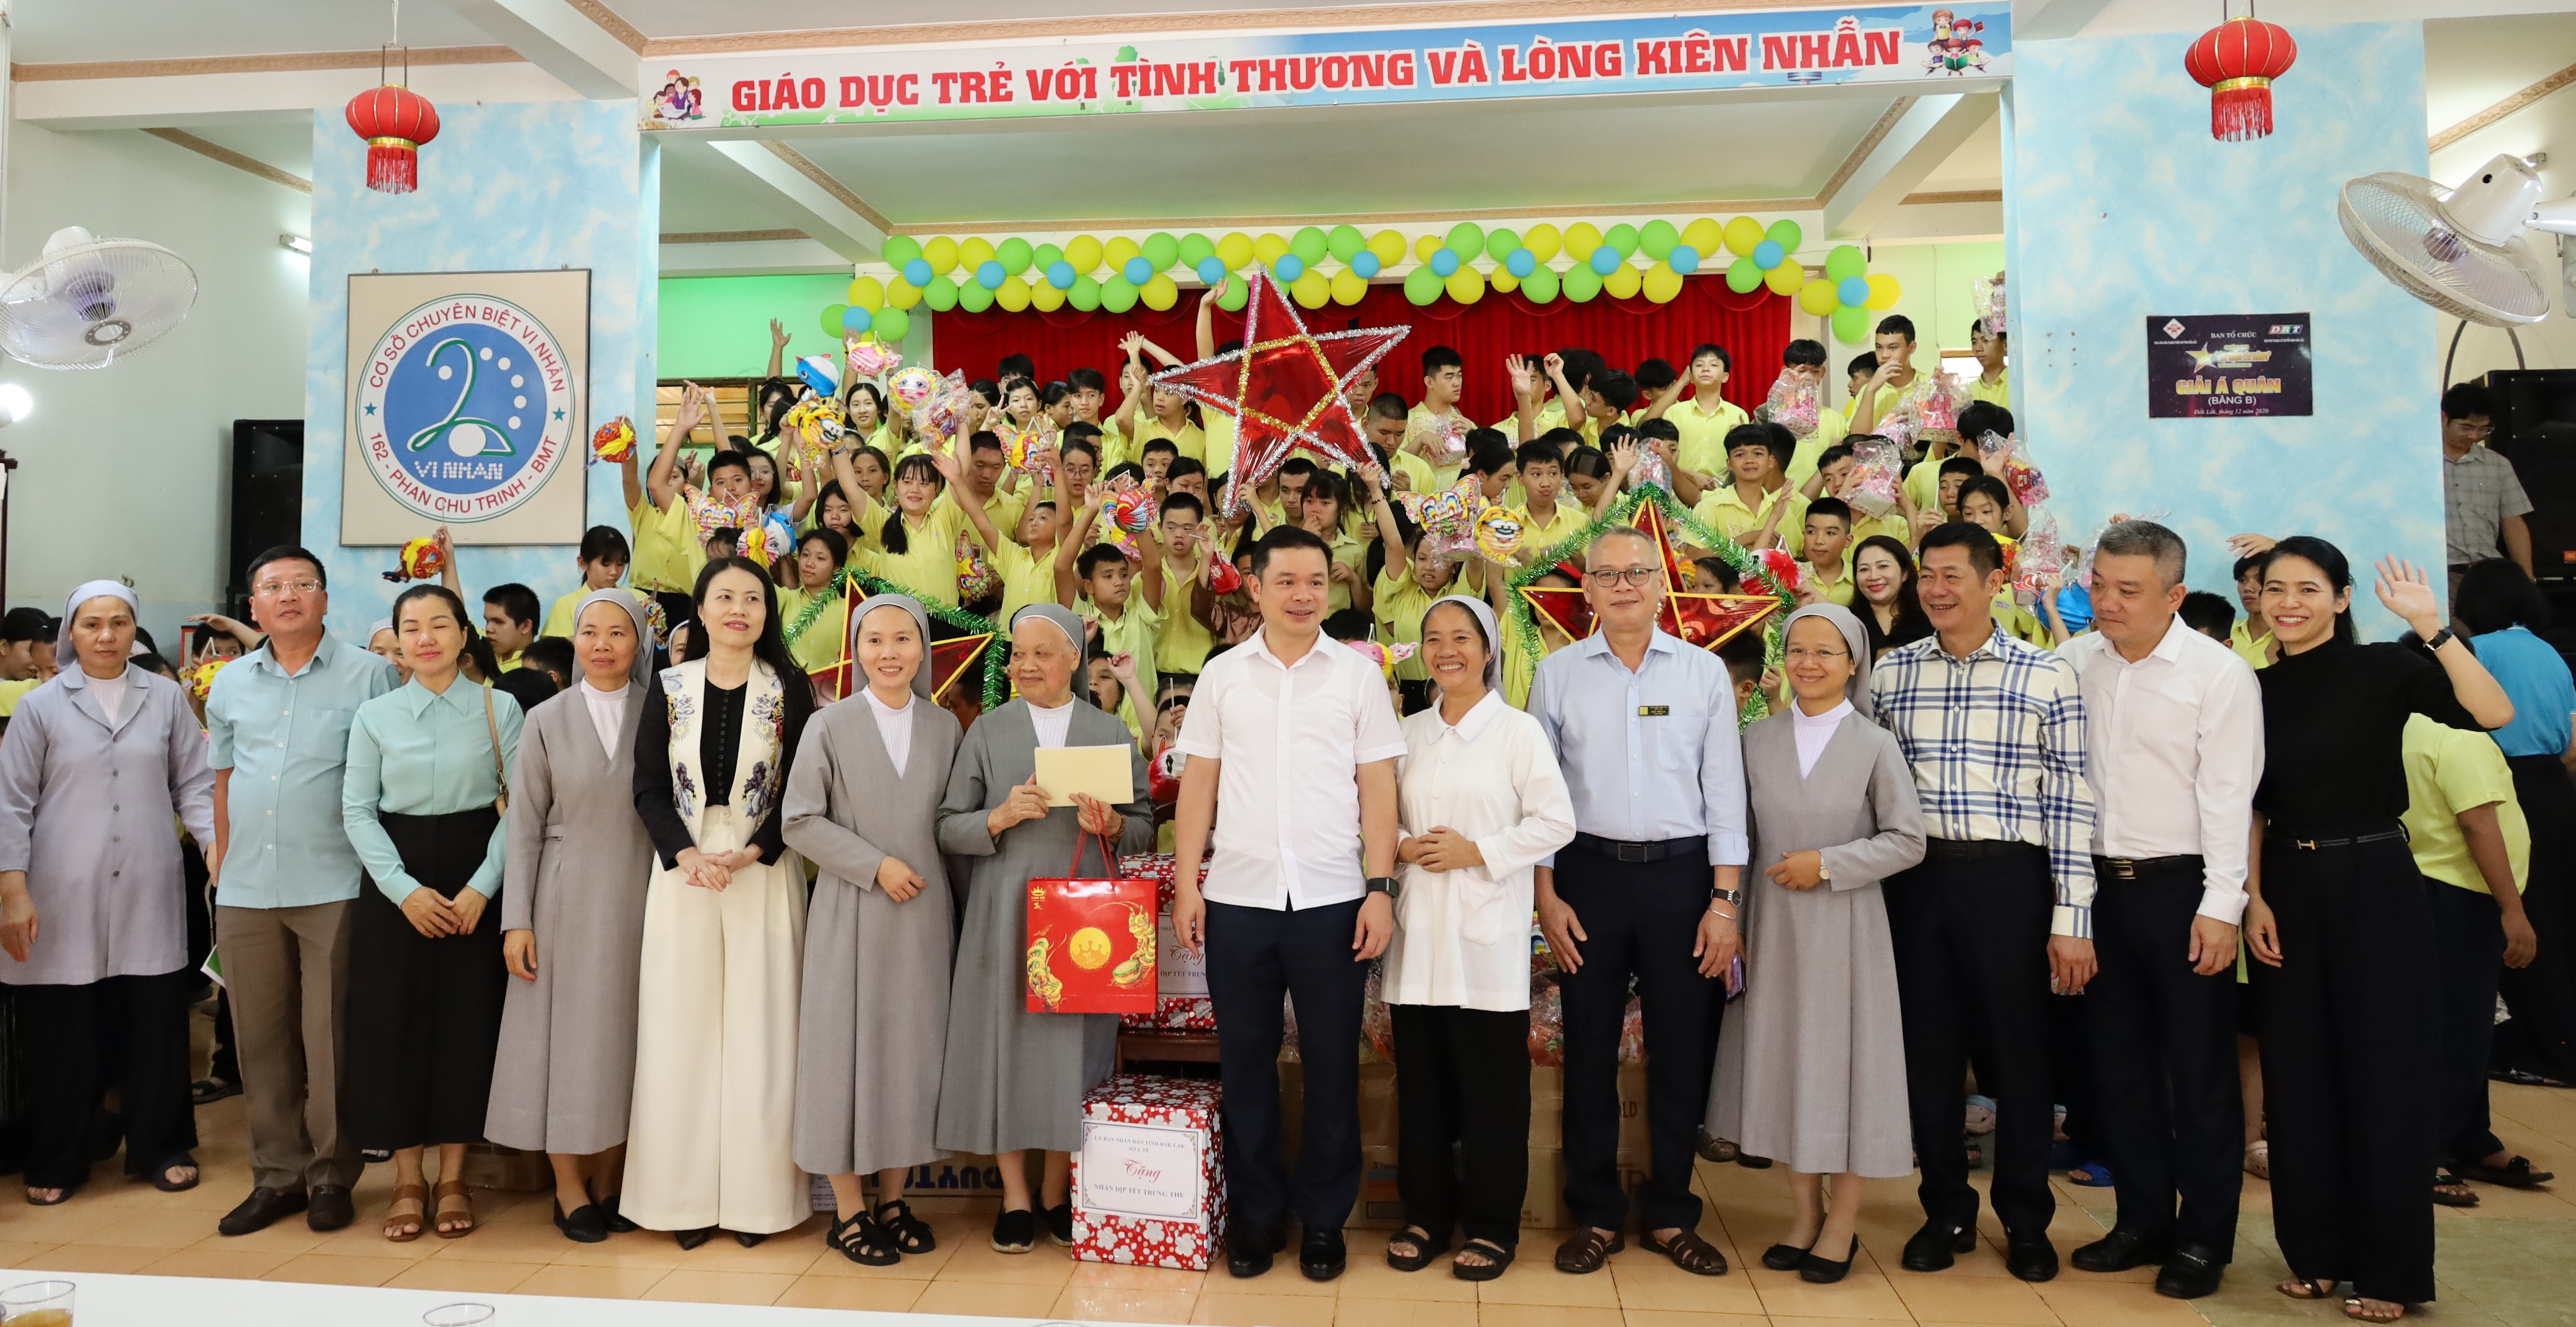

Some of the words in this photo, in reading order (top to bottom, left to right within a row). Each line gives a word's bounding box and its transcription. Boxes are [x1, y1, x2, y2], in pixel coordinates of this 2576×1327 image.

[732, 71, 825, 112] GIÁO
[839, 74, 918, 113] DỤC
[932, 61, 1013, 103] TRẺ
[1026, 61, 1097, 101] VỚI
[1110, 57, 1216, 97] TÌNH
[1229, 50, 1413, 92] THƯƠNG
[1428, 43, 1487, 84] VÀ
[1501, 38, 1621, 81] LÒNG
[1637, 32, 1747, 75] KIÊN
[1762, 20, 1899, 69] NHẪN
[370, 361, 388, 388] CƠ
[384, 333, 406, 360] SỞ
[406, 303, 476, 340] CHUYÊN
[482, 306, 521, 330] BIỆT
[522, 326, 539, 345] VI
[534, 342, 565, 392] NHÂN
[2176, 375, 2212, 395] GIẢI
[2215, 375, 2229, 394] Á
[2232, 375, 2282, 396] QUÂN
[2208, 395, 2243, 406] (BẢNG
[2245, 396, 2257, 406] B)
[370, 432, 388, 460] 162
[389, 469, 432, 506] PHAN
[434, 497, 471, 513] CHU
[475, 478, 526, 511] TRINH
[531, 435, 557, 473] BMT
[414, 460, 438, 478] VI
[443, 461, 503, 480] NHAN
[1122, 1158, 1162, 1183] Tặng
[1094, 1183, 1114, 1191] NHÂN
[1143, 1189, 1168, 1197] TRUNG
